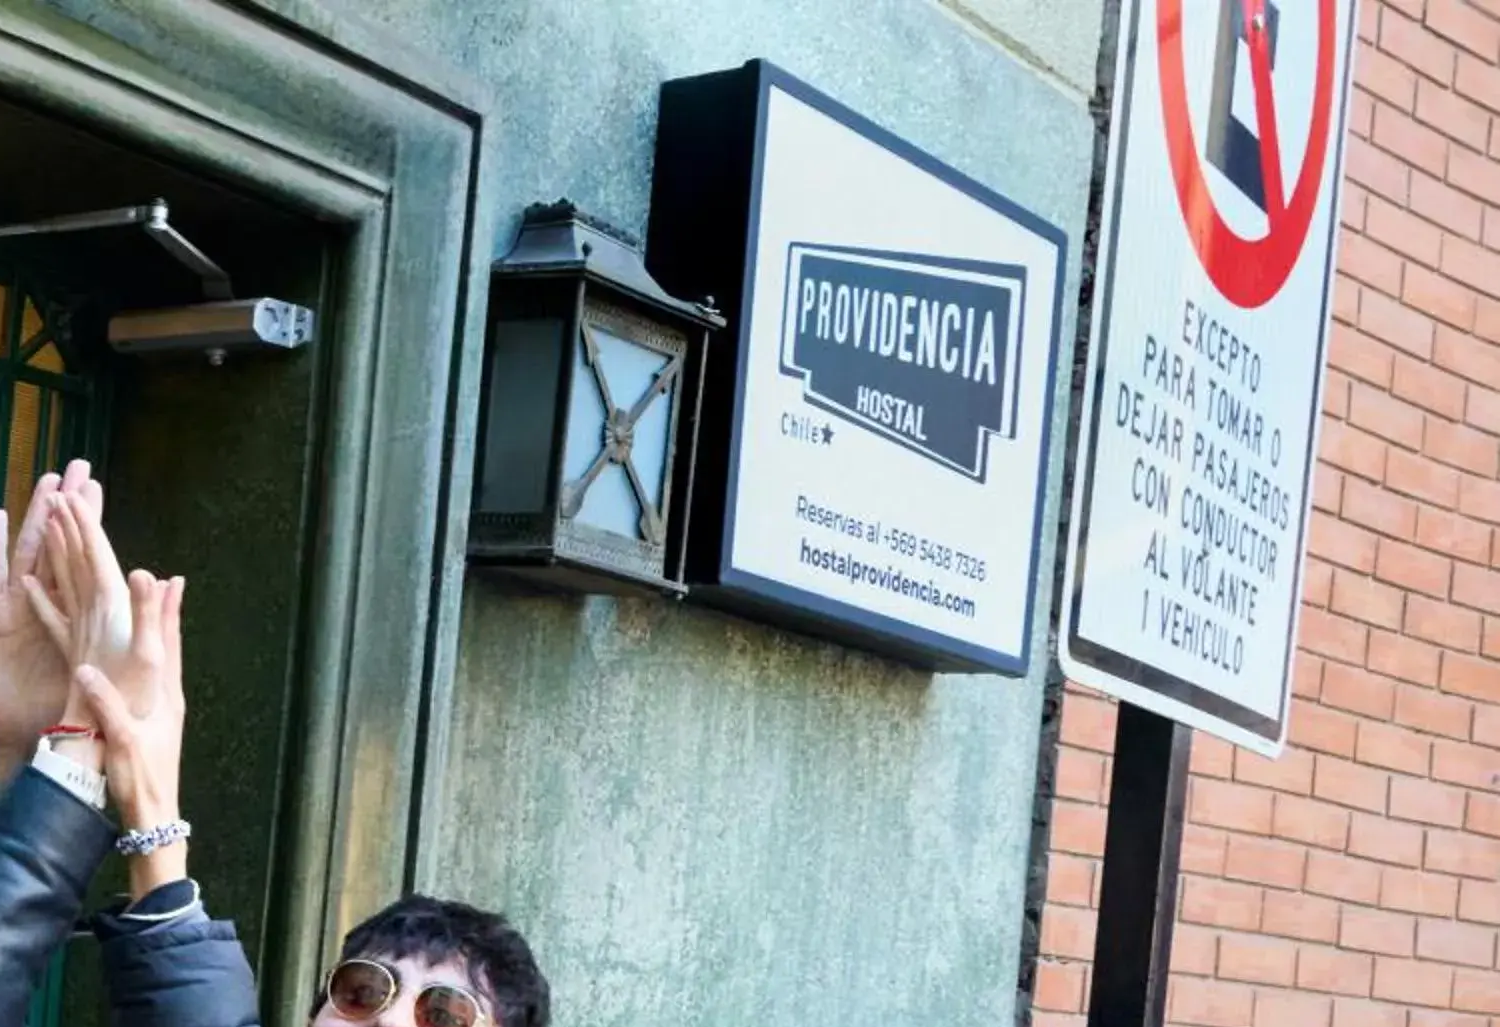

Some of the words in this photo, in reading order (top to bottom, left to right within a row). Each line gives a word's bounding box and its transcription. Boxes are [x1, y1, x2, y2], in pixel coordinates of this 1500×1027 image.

[800, 277, 996, 386] PROVIDENCIA
[1182, 299, 1262, 394] EXCEPTO
[781, 411, 819, 445] Chile
[856, 385, 927, 441] HOSTAL
[1143, 334, 1196, 411] PARA
[1207, 377, 1263, 457] TOMAR
[1270, 427, 1282, 468] O
[1116, 381, 1185, 464] DEJAR
[1192, 431, 1290, 531] PASAJEROS
[796, 495, 864, 539] Reservas
[866, 521, 881, 544] al
[884, 529, 917, 558] +569
[1132, 457, 1171, 518] CON
[1181, 486, 1279, 582] CONDUCTOR
[800, 538, 976, 618] hostalprovidencia.com
[1144, 528, 1169, 581] AL
[1180, 545, 1258, 627] VOLANTE
[1160, 597, 1244, 675] VEHICULO
